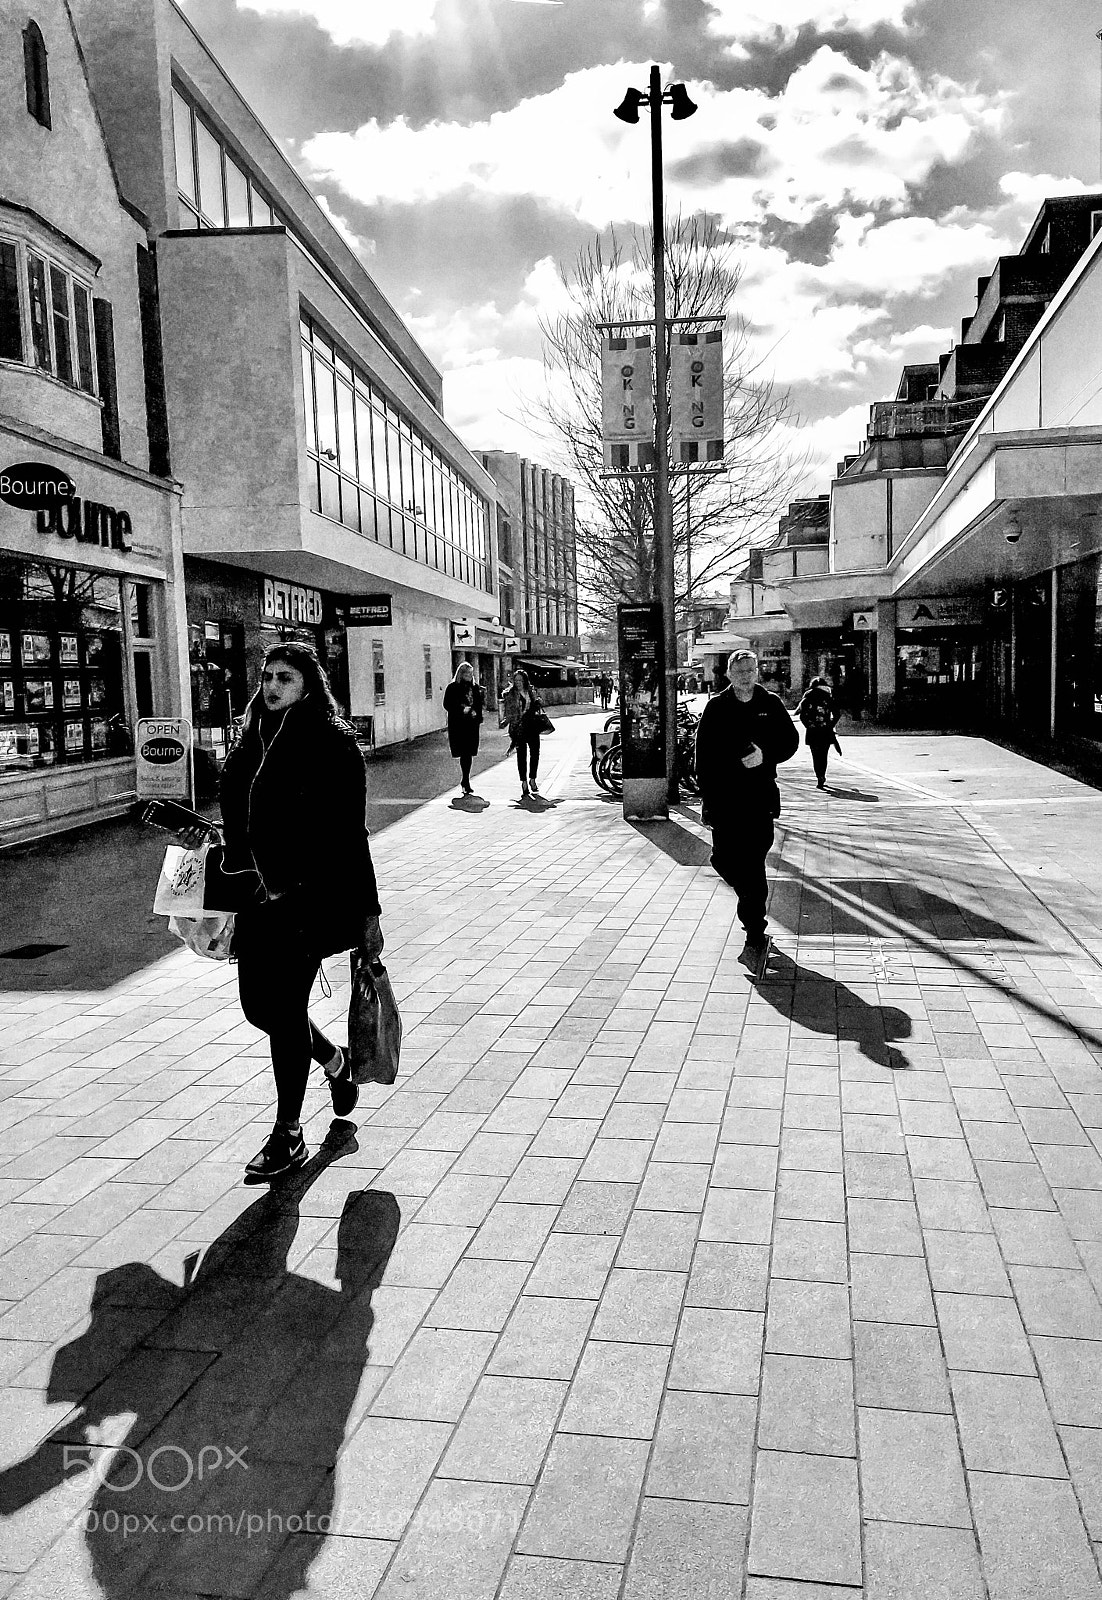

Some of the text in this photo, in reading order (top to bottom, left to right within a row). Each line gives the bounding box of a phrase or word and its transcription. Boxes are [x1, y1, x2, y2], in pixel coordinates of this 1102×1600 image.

[0, 475, 69, 496] Bourne
[263, 578, 323, 625] BETFRED
[350, 605, 389, 614] BETFRED
[147, 724, 180, 735] OPEN
[142, 744, 182, 757] Bourne
